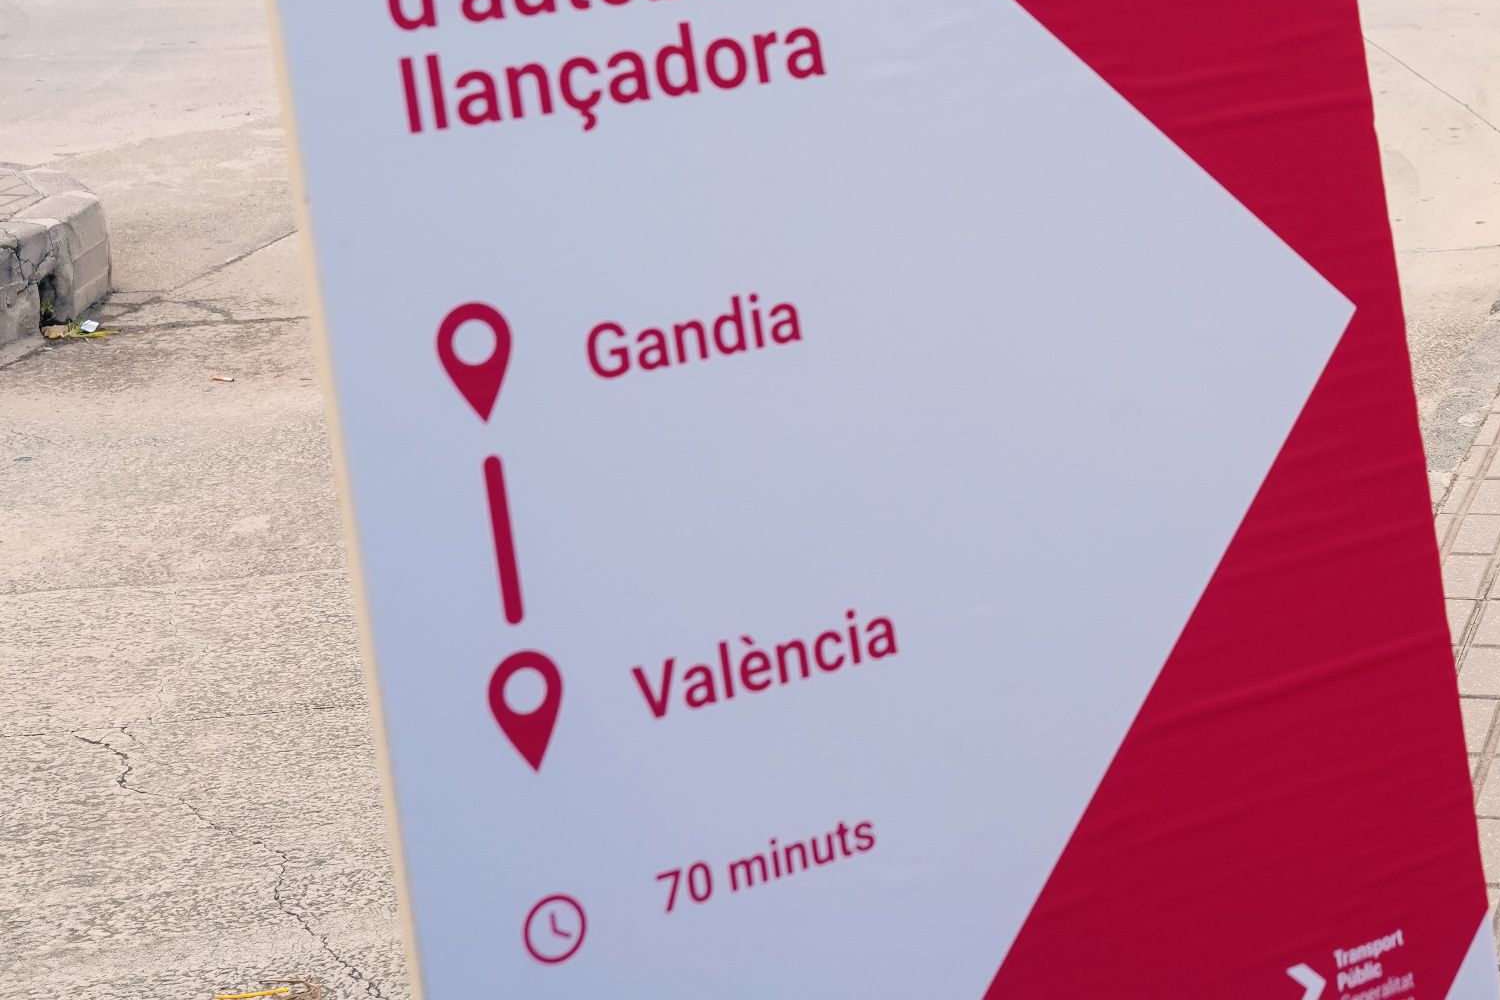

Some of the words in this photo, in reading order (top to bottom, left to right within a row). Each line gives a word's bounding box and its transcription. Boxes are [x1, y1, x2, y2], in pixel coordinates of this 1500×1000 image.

[399, 21, 827, 134] llançadora
[585, 293, 803, 380] Gandia
[631, 608, 898, 719] València
[655, 861, 714, 914] 70
[728, 820, 876, 892] minuts
[1332, 929, 1405, 970] Transport
